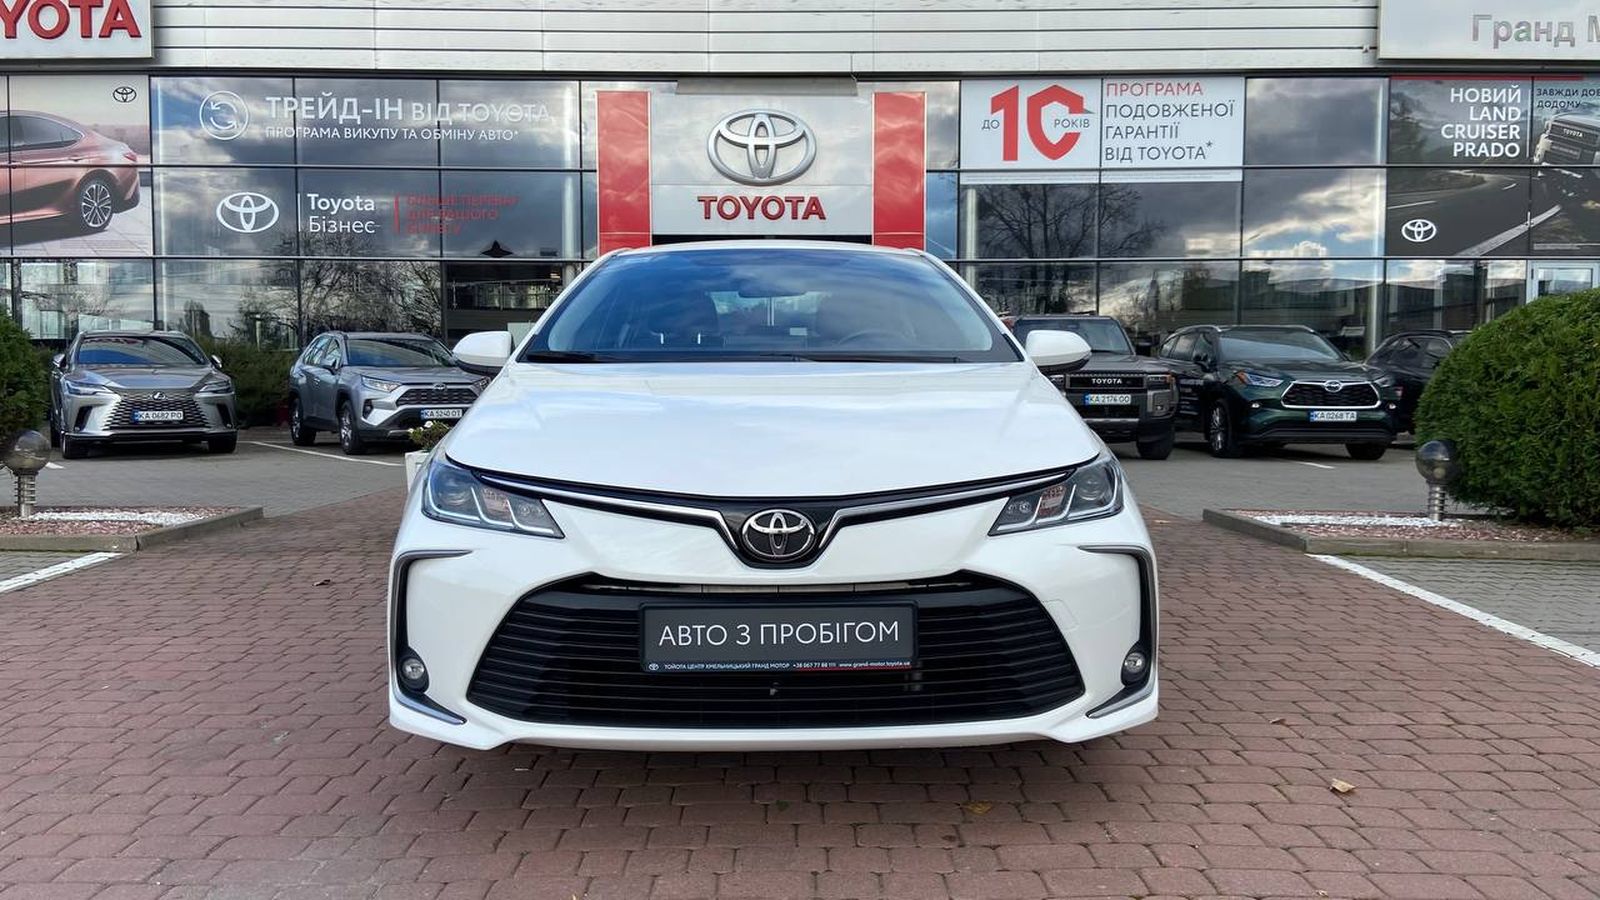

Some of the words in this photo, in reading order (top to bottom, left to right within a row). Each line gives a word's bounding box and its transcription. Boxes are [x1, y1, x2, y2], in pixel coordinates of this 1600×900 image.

[1472, 14, 1576, 49] Гранд
[1106, 82, 1203, 97] ПРОГРАМА
[1450, 84, 1521, 103] НОВИЙ
[1536, 88, 1579, 97] ЗАВЖДИ
[265, 91, 402, 124] ТРЕЙД-ІН
[411, 102, 452, 125] ВІД
[458, 102, 550, 122] TOYOTA
[1106, 99, 1235, 120] ПОДОВЖЕНОЇ
[1537, 100, 1581, 109] ДОДОМУ
[1470, 106, 1521, 121] LAND
[981, 119, 1000, 130] ДО
[1053, 118, 1090, 129] РОКІВ
[1105, 121, 1180, 139] ГАРАНТІЇ
[1441, 123, 1520, 139] CRUISER
[265, 127, 340, 139] ПРОГРАМА
[344, 127, 399, 139] ВИКУПУ
[402, 128, 417, 140] ТА
[420, 128, 476, 140] ОБМІНУ
[1105, 147, 1133, 163] ВІД
[1453, 142, 1520, 158] PRADO
[306, 193, 375, 215] Toyota
[697, 195, 827, 221] TOYOTA
[309, 215, 376, 233] Бізнес
[139, 411, 150, 419] KA
[1315, 411, 1325, 419] KA
[658, 624, 728, 647] АВТО
[760, 621, 899, 645] ПРОБІГОМ
